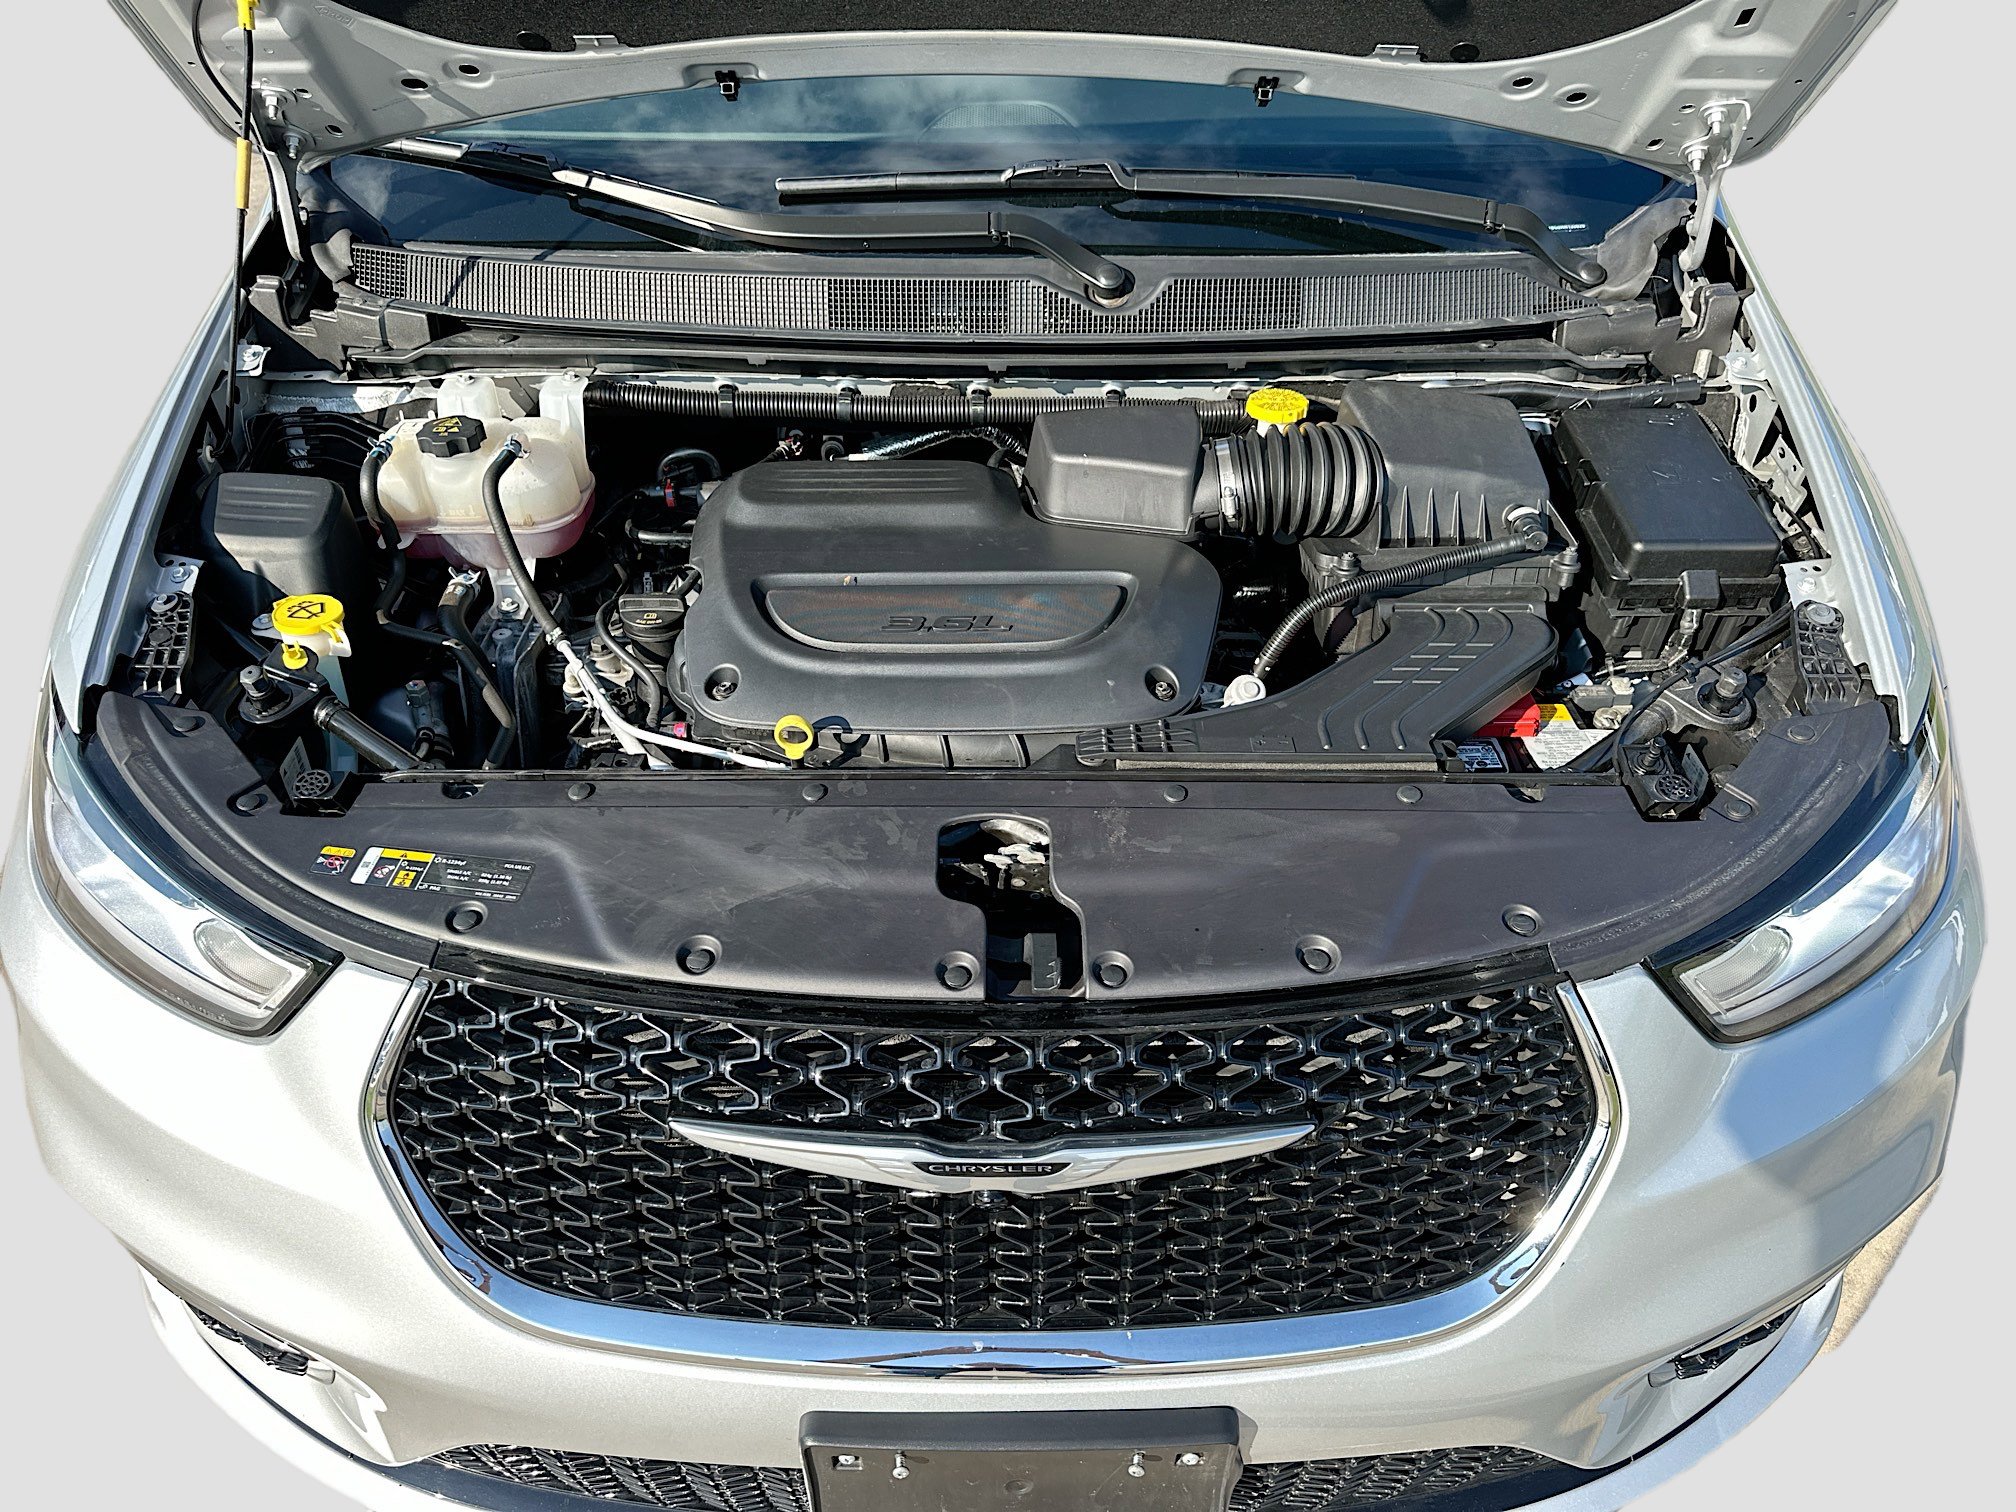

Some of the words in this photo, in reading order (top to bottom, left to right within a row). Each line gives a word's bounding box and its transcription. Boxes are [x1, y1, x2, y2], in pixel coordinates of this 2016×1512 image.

[881, 614, 1014, 634] 3.6L
[441, 858, 467, 866] R-1234yf
[928, 1164, 1053, 1173] CHRYSLER
